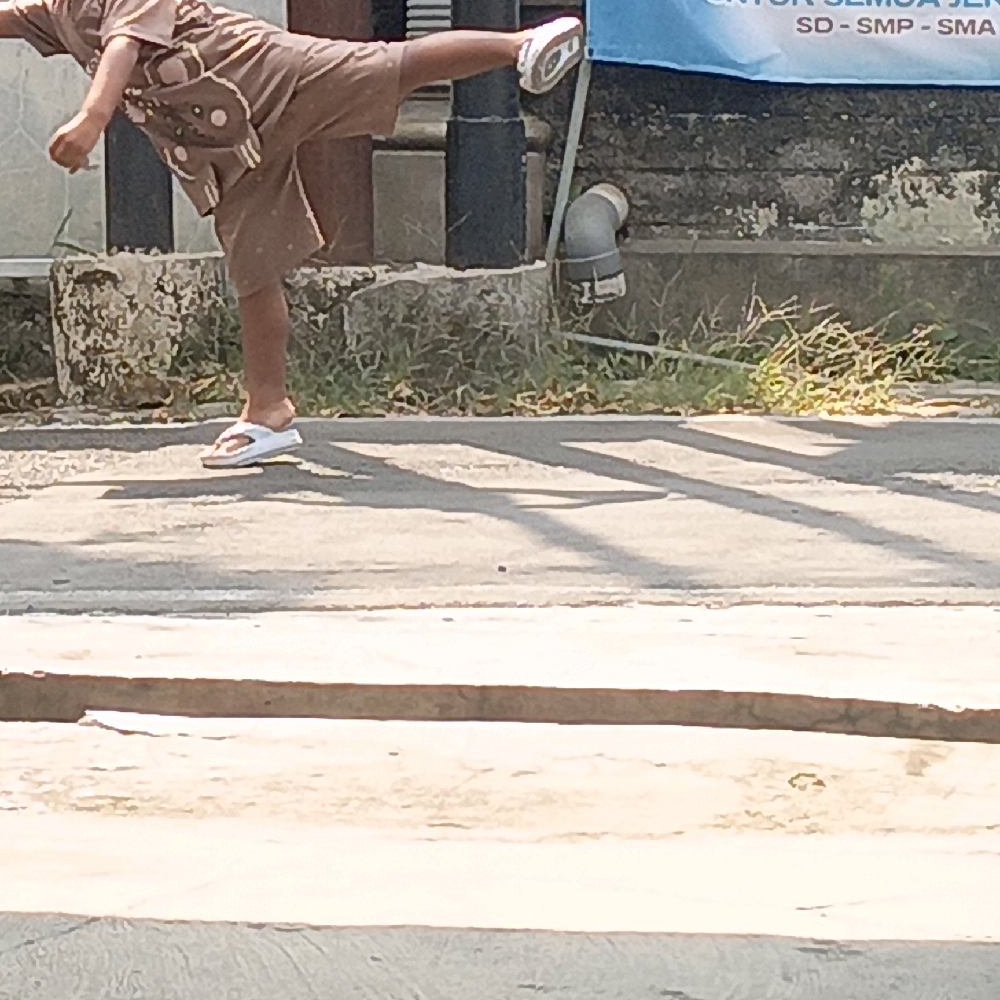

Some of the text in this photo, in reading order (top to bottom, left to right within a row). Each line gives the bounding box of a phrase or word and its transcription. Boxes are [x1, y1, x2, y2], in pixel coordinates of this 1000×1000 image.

[796, 16, 834, 34] SD
[856, 17, 915, 35] SMP
[937, 18, 997, 36] SMA
